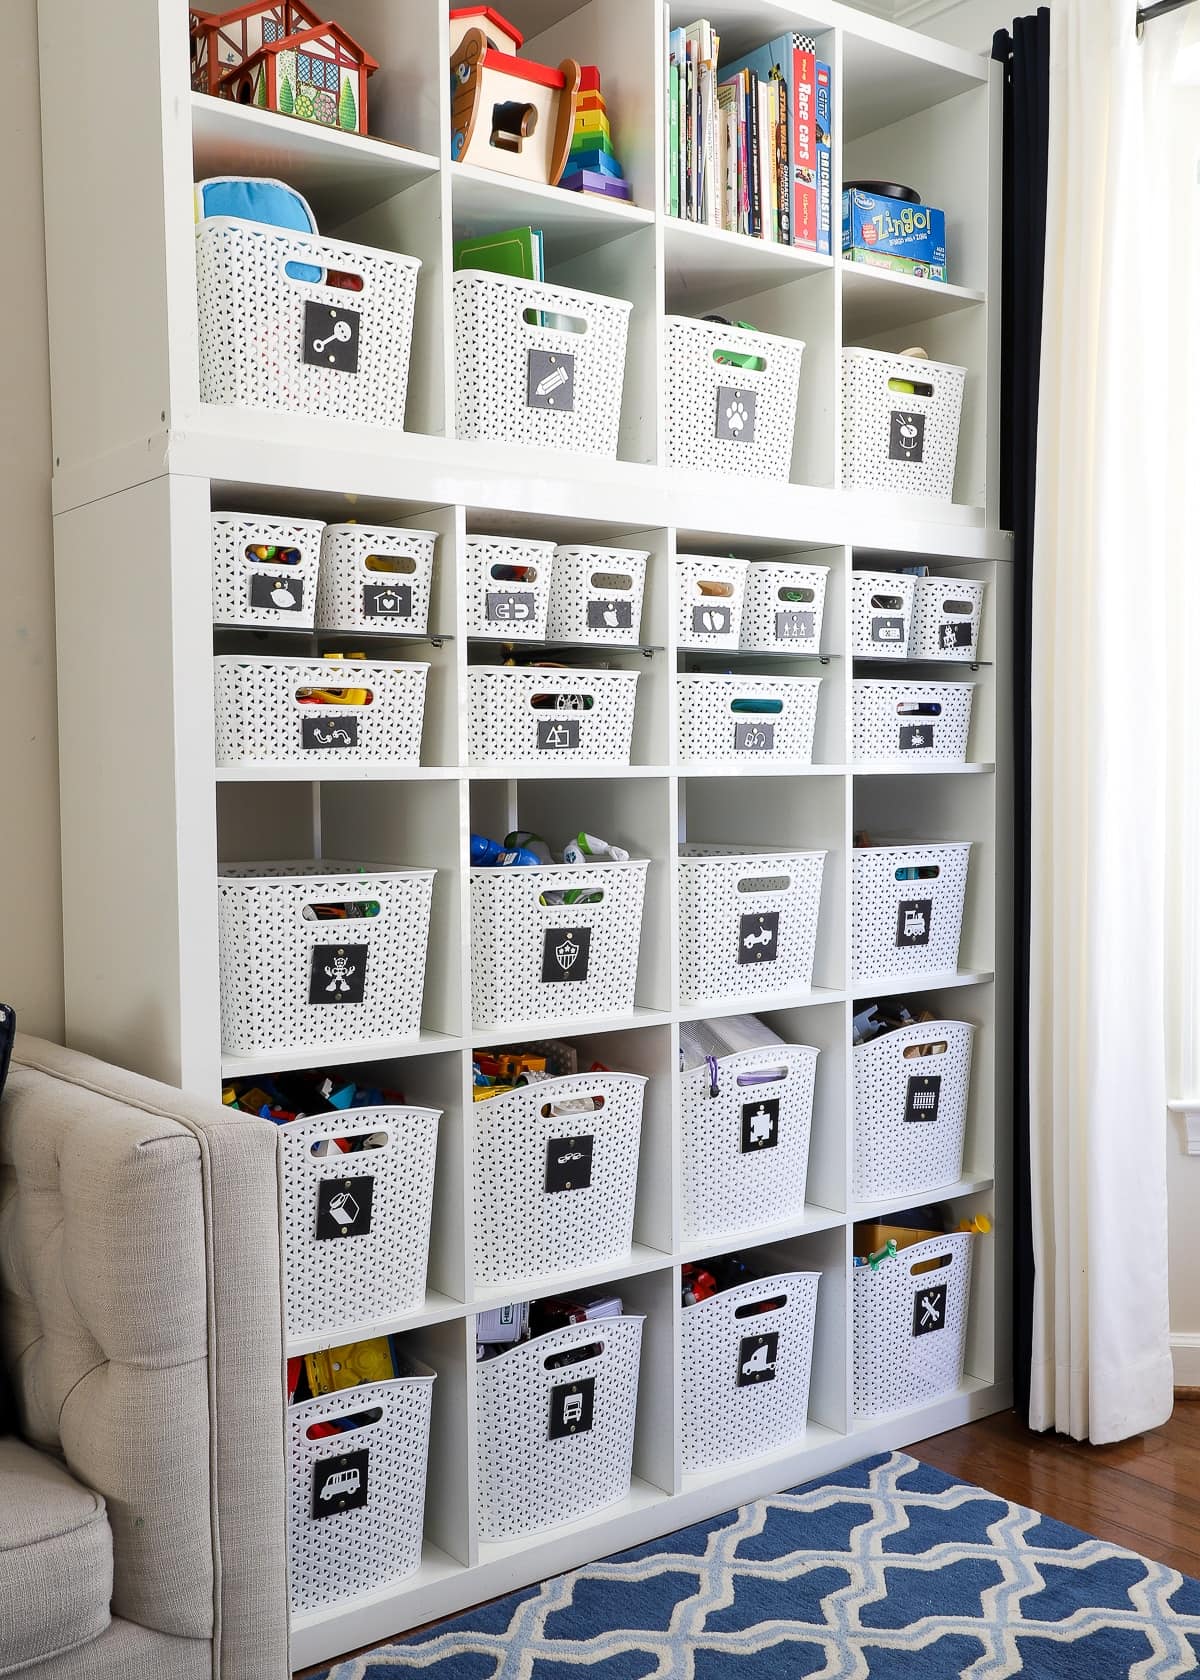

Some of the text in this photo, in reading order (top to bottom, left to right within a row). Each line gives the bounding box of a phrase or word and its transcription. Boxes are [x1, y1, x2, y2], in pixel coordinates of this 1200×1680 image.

[799, 83, 811, 120] Race
[780, 125, 788, 161] WARS
[799, 123, 811, 161] cars
[821, 151, 830, 231] BRICKMASTER
[872, 208, 932, 241] Zingo!
